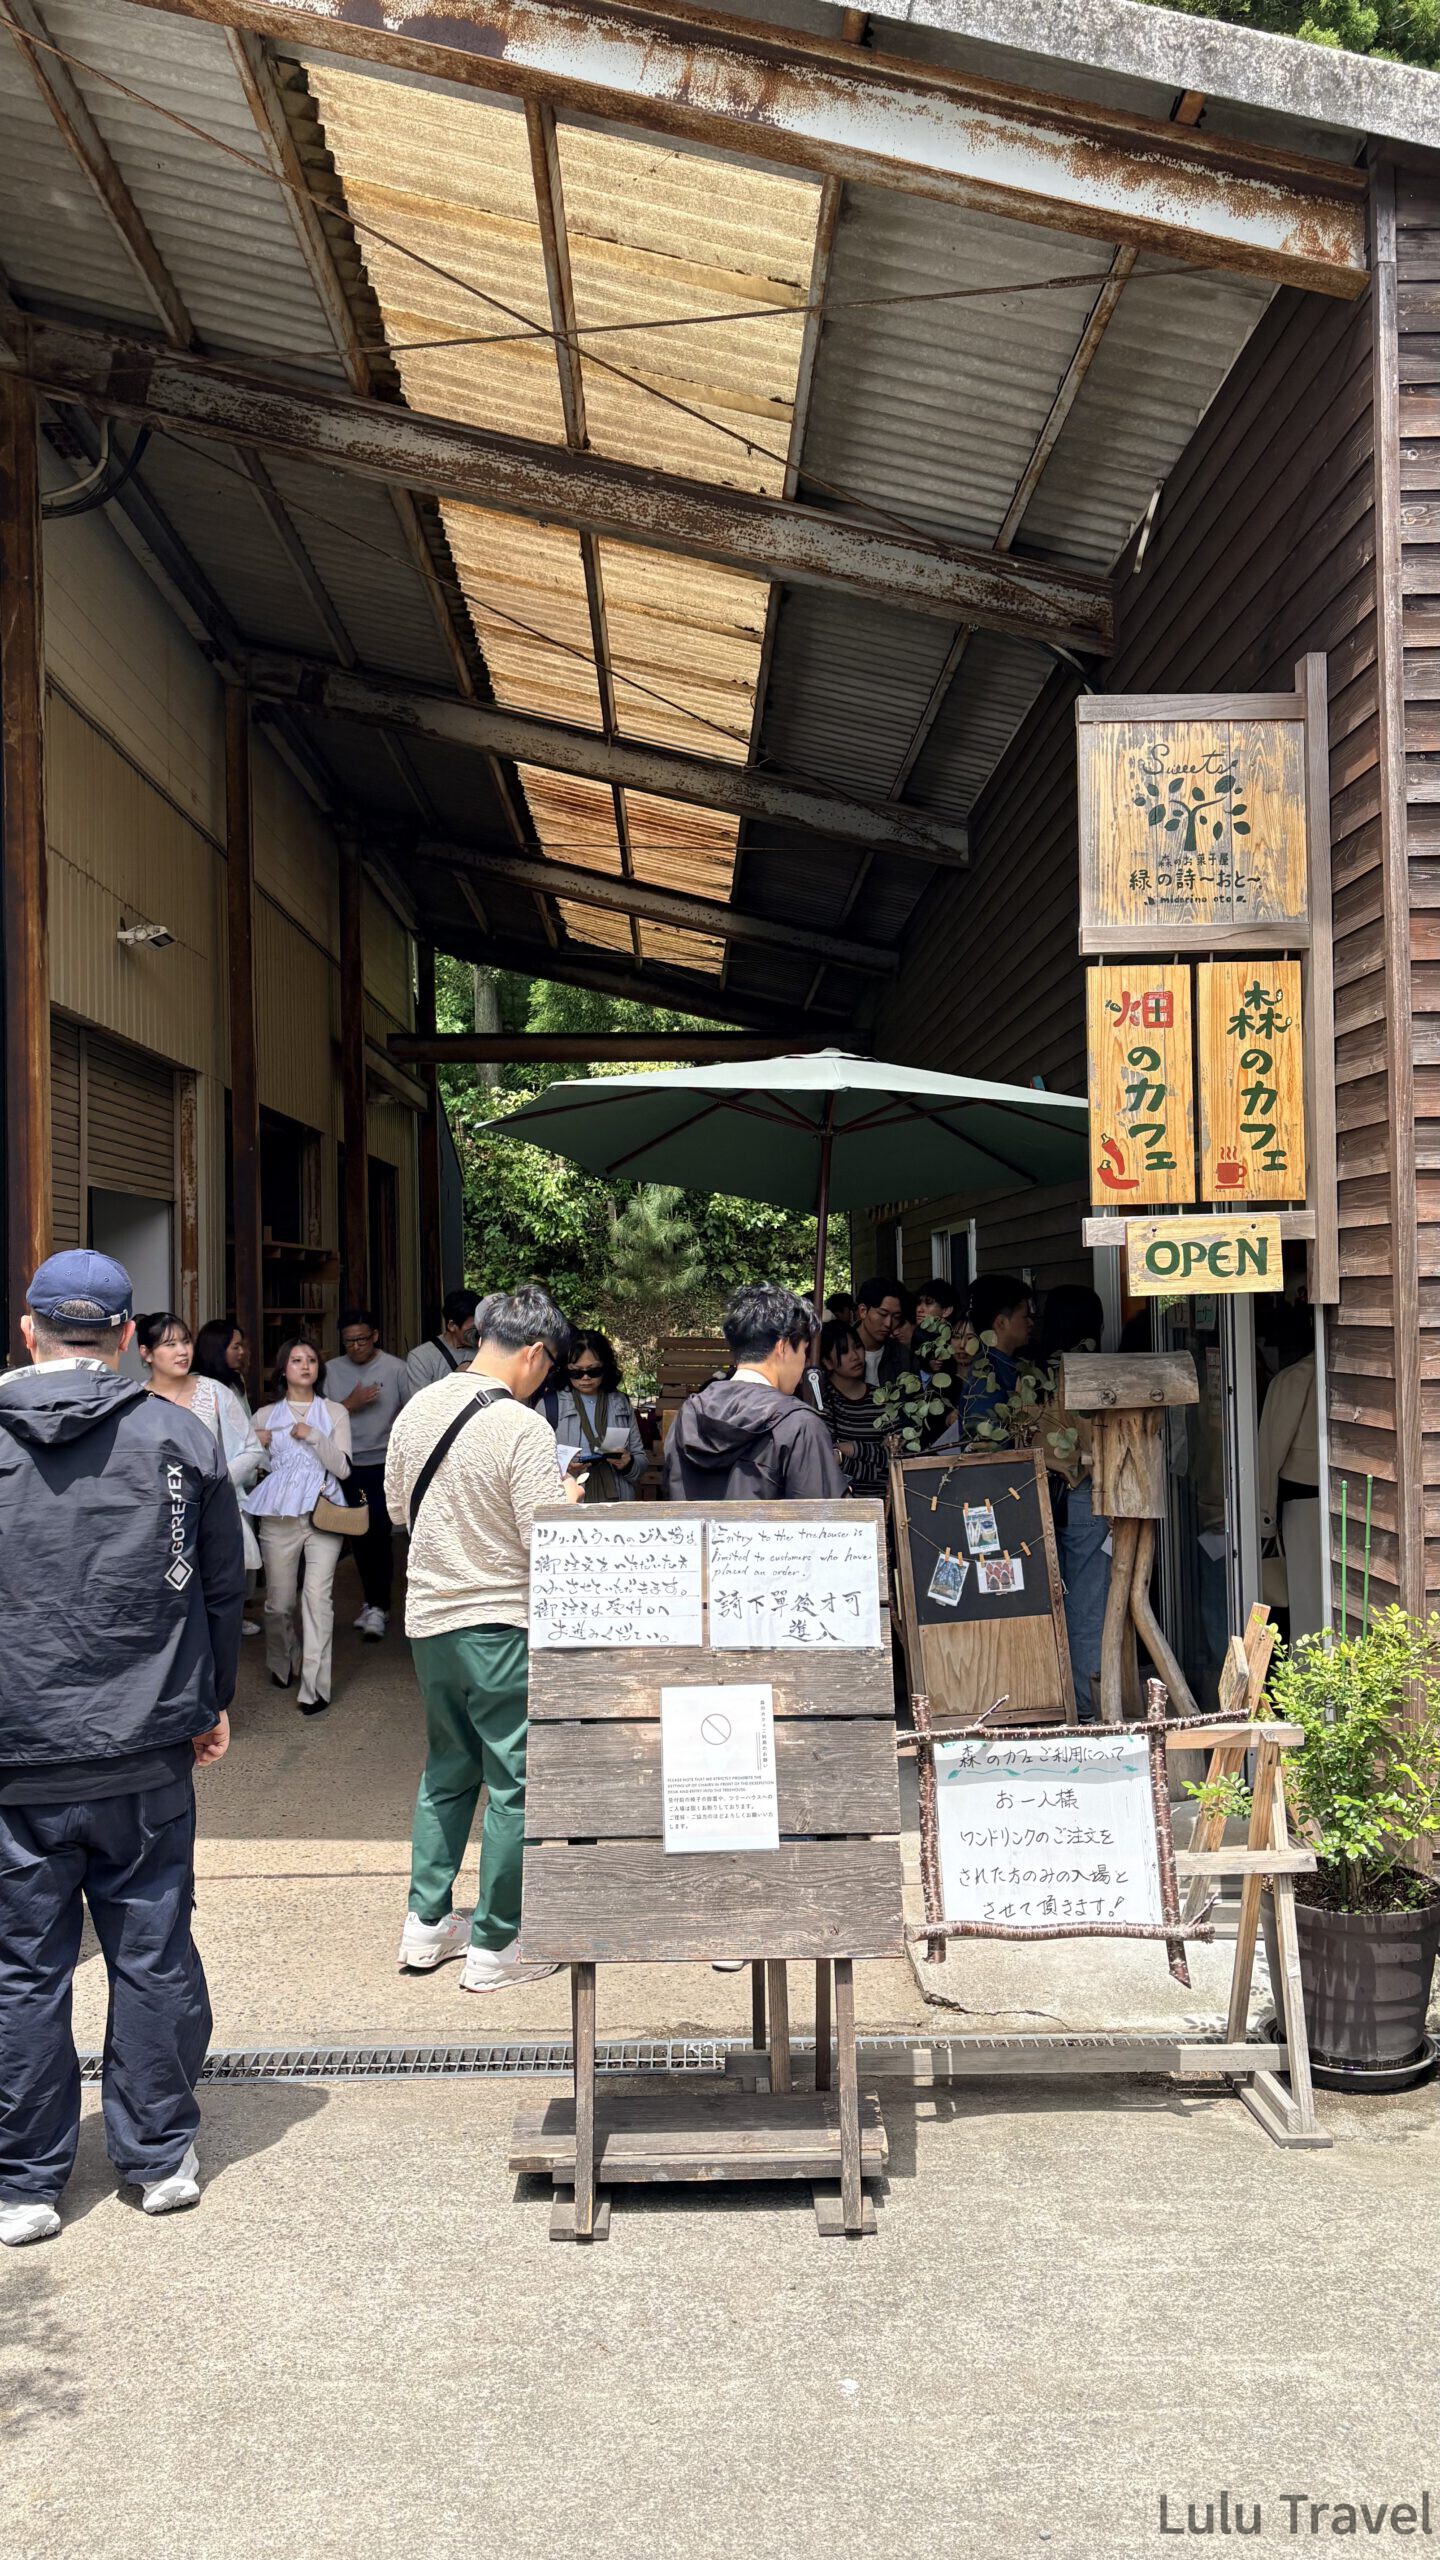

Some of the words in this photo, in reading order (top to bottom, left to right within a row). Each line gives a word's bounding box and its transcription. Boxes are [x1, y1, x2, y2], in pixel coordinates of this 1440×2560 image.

[1142, 743, 1237, 775] Sweets
[1158, 853, 1229, 868] 森のお菓子屋
[1213, 895, 1231, 904] oto
[1105, 990, 1177, 1171] 畑のカフェ
[1226, 980, 1292, 1172] 森のカフェ
[1145, 1236, 1269, 1278] OPEN
[166, 1463, 187, 1555] GORE-TEX
[711, 1525, 753, 1547] Entry
[758, 1530, 771, 1542] to
[774, 1528, 794, 1542] the
[853, 1528, 863, 1537] is
[754, 1552, 765, 1562] to
[770, 1552, 812, 1562] customers
[820, 1549, 838, 1562] who
[844, 1547, 872, 1562] have
[711, 1563, 749, 1582] placed
[753, 1569, 766, 1577] an
[781, 1619, 845, 1642] 進入
[958, 1744, 1125, 1768] 森のカフェご利用について
[995, 1787, 1080, 1810] お一人様
[960, 1826, 1115, 1848] ワンドリンクのご注文を
[958, 1863, 1129, 1887] された方のみの入場と
